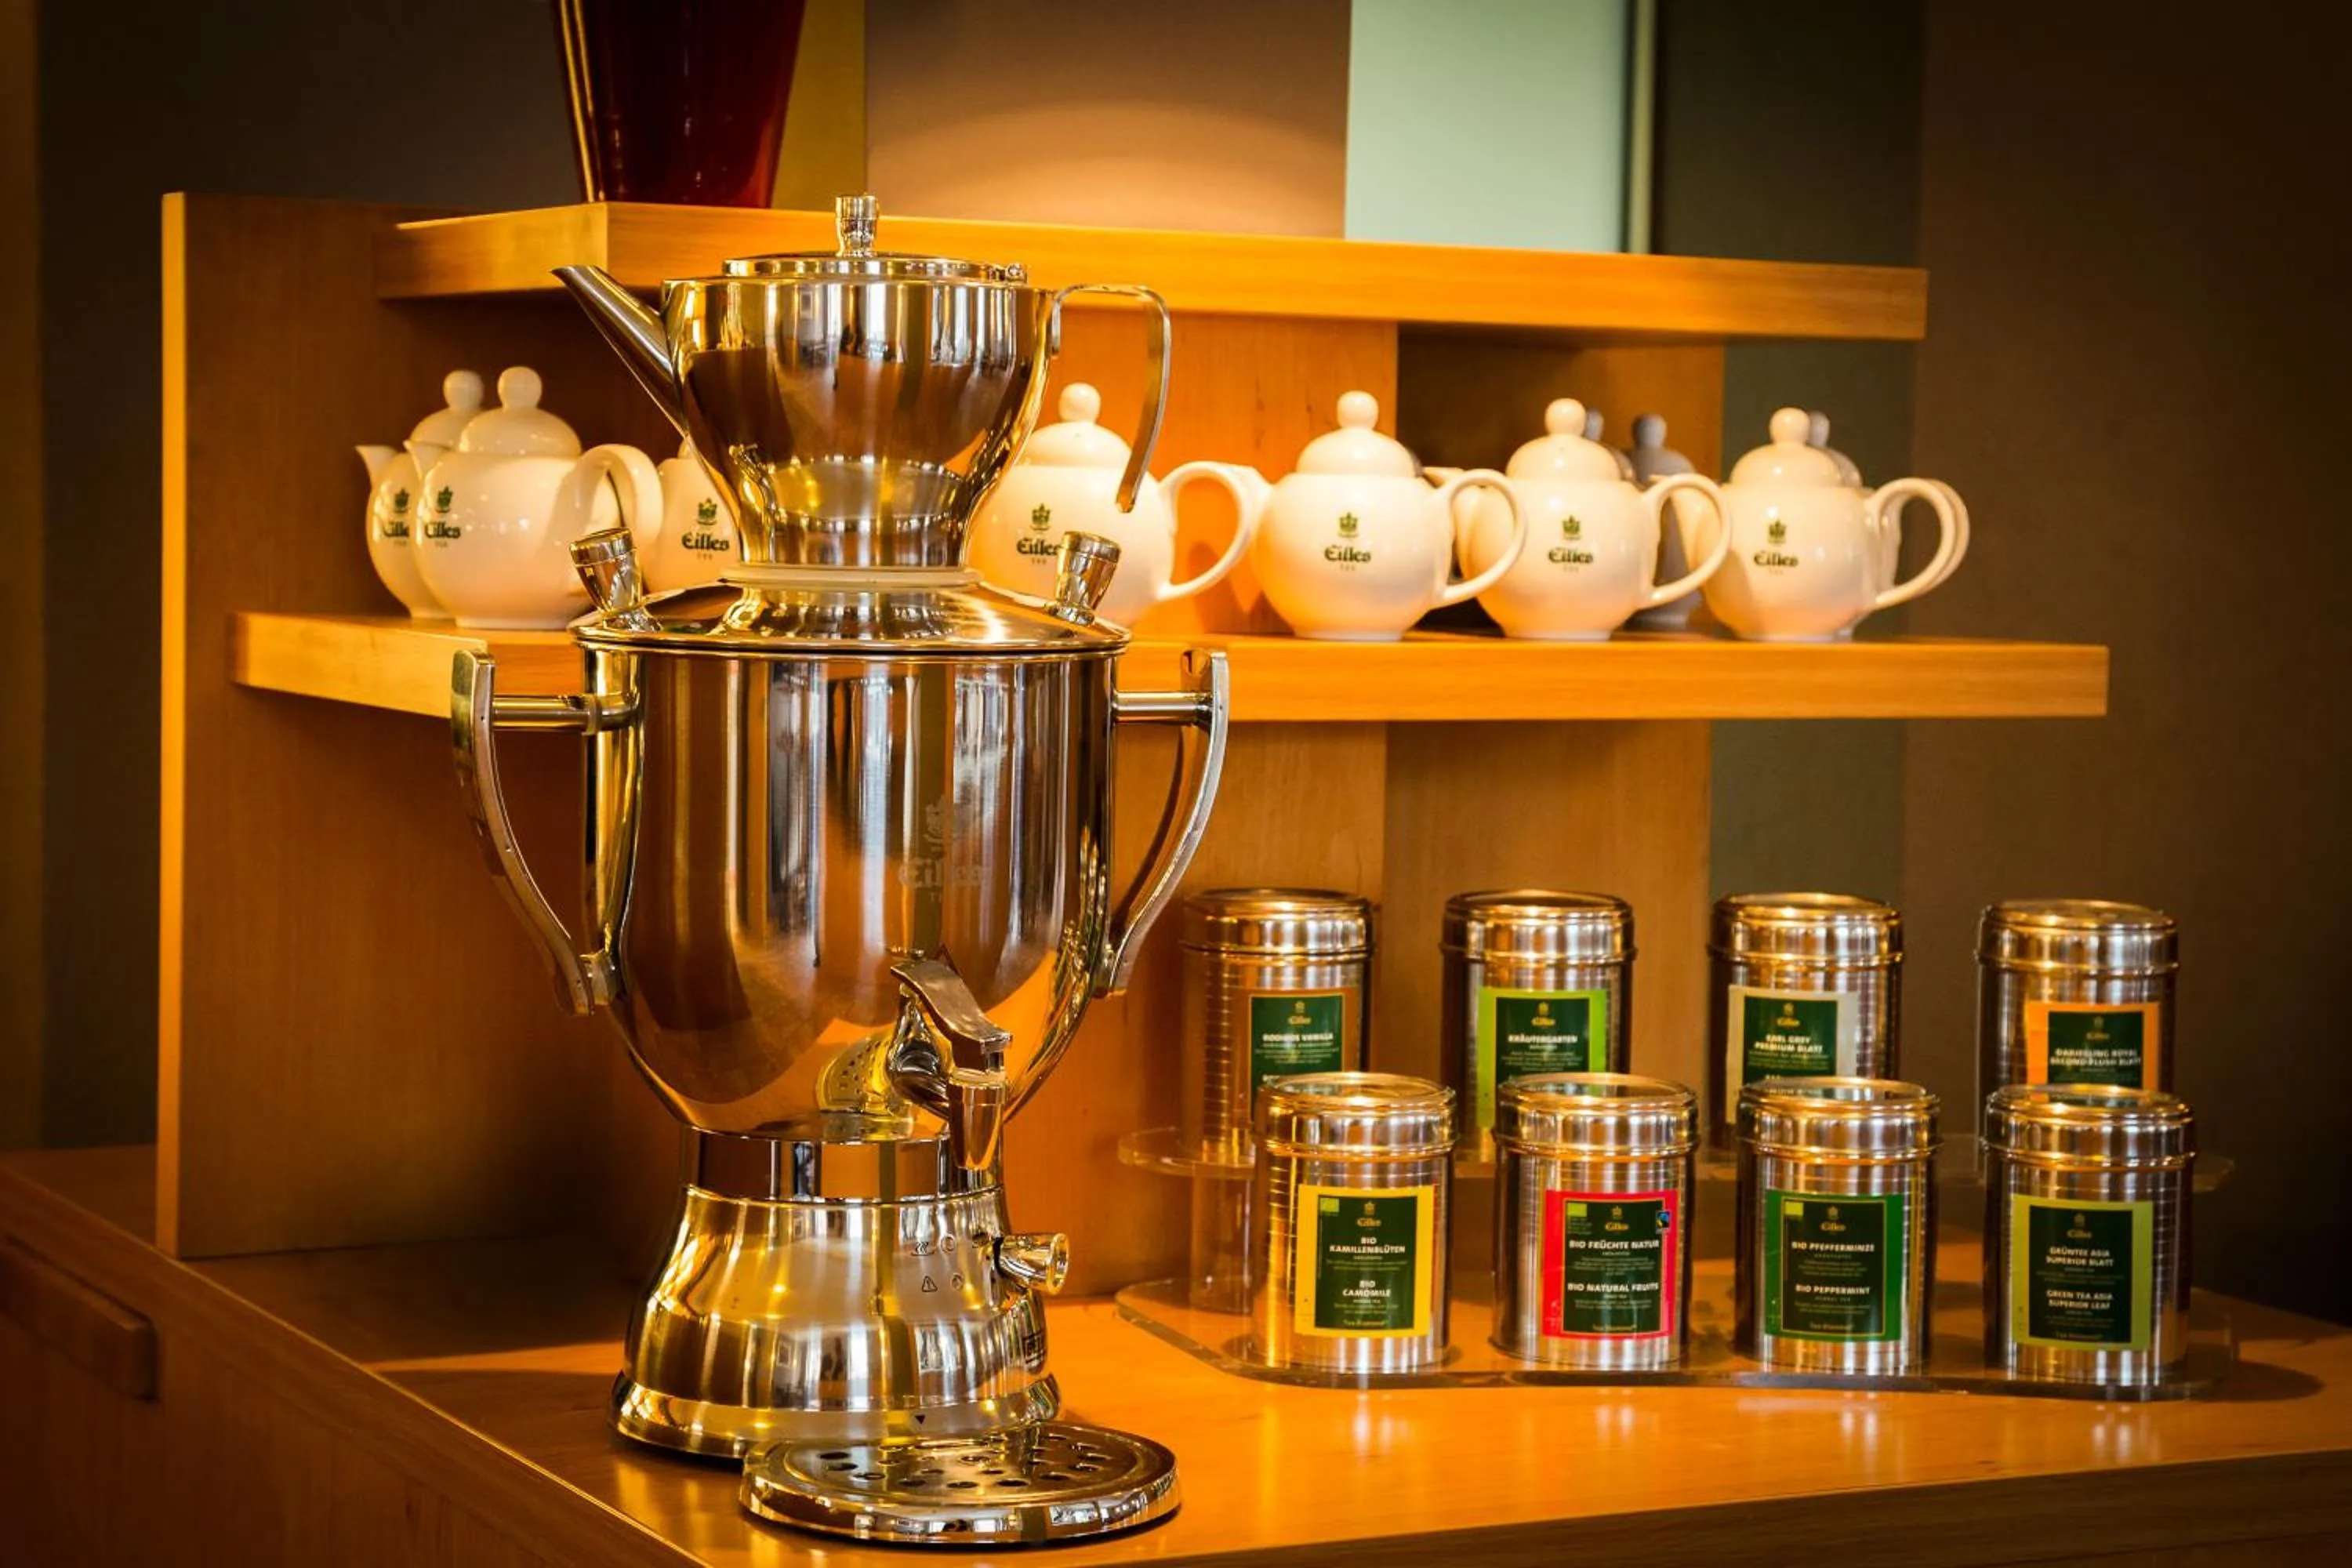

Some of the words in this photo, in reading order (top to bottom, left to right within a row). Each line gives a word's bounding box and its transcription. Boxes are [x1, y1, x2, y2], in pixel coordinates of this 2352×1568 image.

[383, 521, 410, 538] Eille
[424, 521, 462, 539] Eilles
[681, 532, 730, 552] Eilles
[1324, 544, 1371, 563] Eilles
[1548, 546, 1593, 564] Eilles
[1753, 550, 1799, 568] Eilles
[1508, 1033, 1578, 1044] KRÄUTERGARTEN
[1766, 1034, 1786, 1043] EARL
[1788, 1035, 1811, 1044] GREY
[1755, 1042, 1795, 1052] PREMIUM
[1797, 1044, 1823, 1054] BLATT
[1360, 1236, 1377, 1245] BIO
[1569, 1240, 1586, 1249] BIO
[1588, 1239, 1629, 1249] FRÜCHTE
[1631, 1240, 1660, 1249] NATUR
[1329, 1244, 1406, 1254] KAMILLENBLÜTEN
[1809, 1243, 1875, 1252] PFEFFERMINZE
[2049, 1246, 2089, 1257] GRÜNTEE
[2090, 1249, 2111, 1258] ASIA
[2045, 1256, 2087, 1266] SUPERIOR
[2089, 1258, 2114, 1267] BLATT
[1567, 1283, 1584, 1291] BIO
[1587, 1283, 1630, 1293] NATURAL
[1632, 1282, 1659, 1290] FRUITS
[1813, 1285, 1871, 1294] PEPPERMINT
[2046, 1290, 2074, 1299] GREEN
[2049, 1299, 2089, 1308] SUPERIOR
[2091, 1301, 2111, 1310] LEAF
